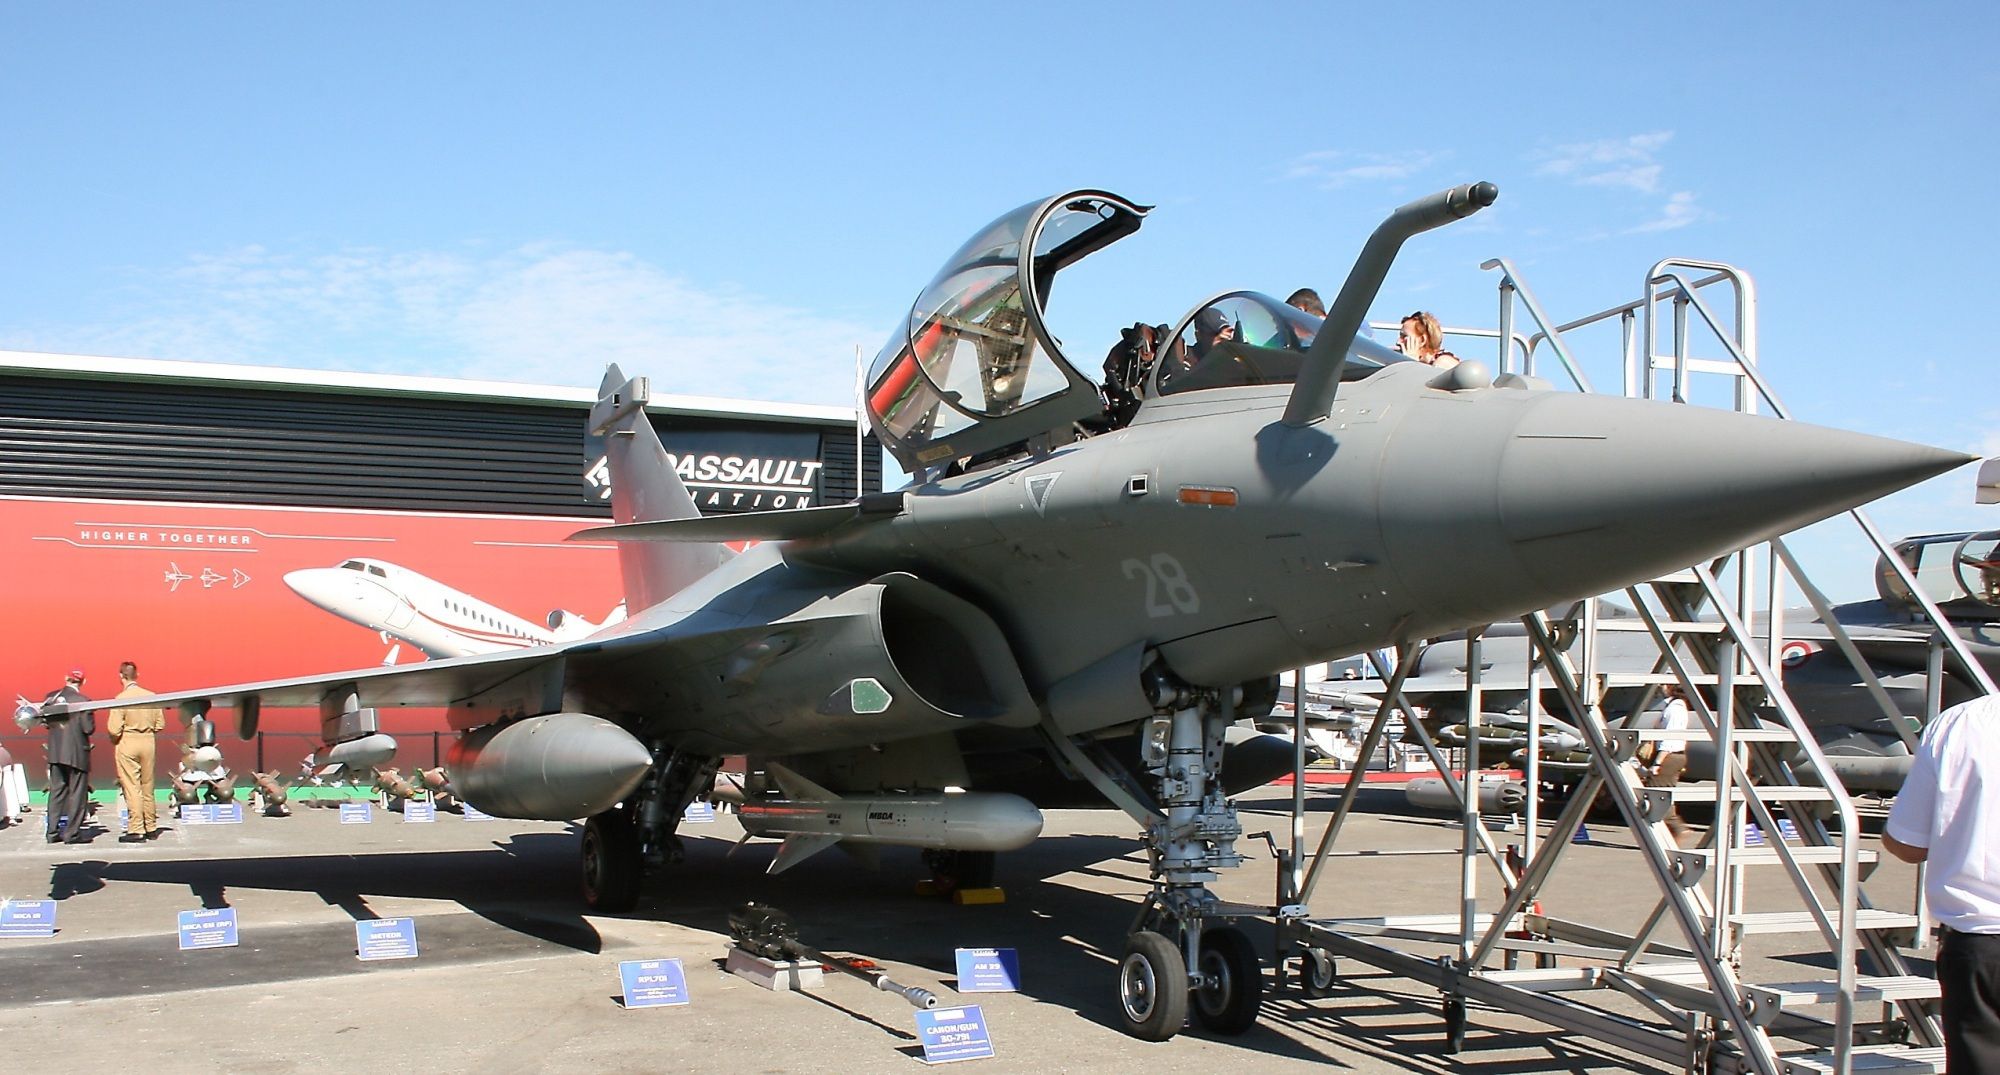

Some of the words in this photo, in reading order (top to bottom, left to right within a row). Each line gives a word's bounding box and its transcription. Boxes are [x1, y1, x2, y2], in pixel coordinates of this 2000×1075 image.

[80, 530, 148, 541] HIGHER
[159, 533, 250, 544] TOGETHER
[1121, 552, 1200, 618] 28
[868, 811, 893, 820] MBDA
[926, 1022, 979, 1035] CANON/GUN
